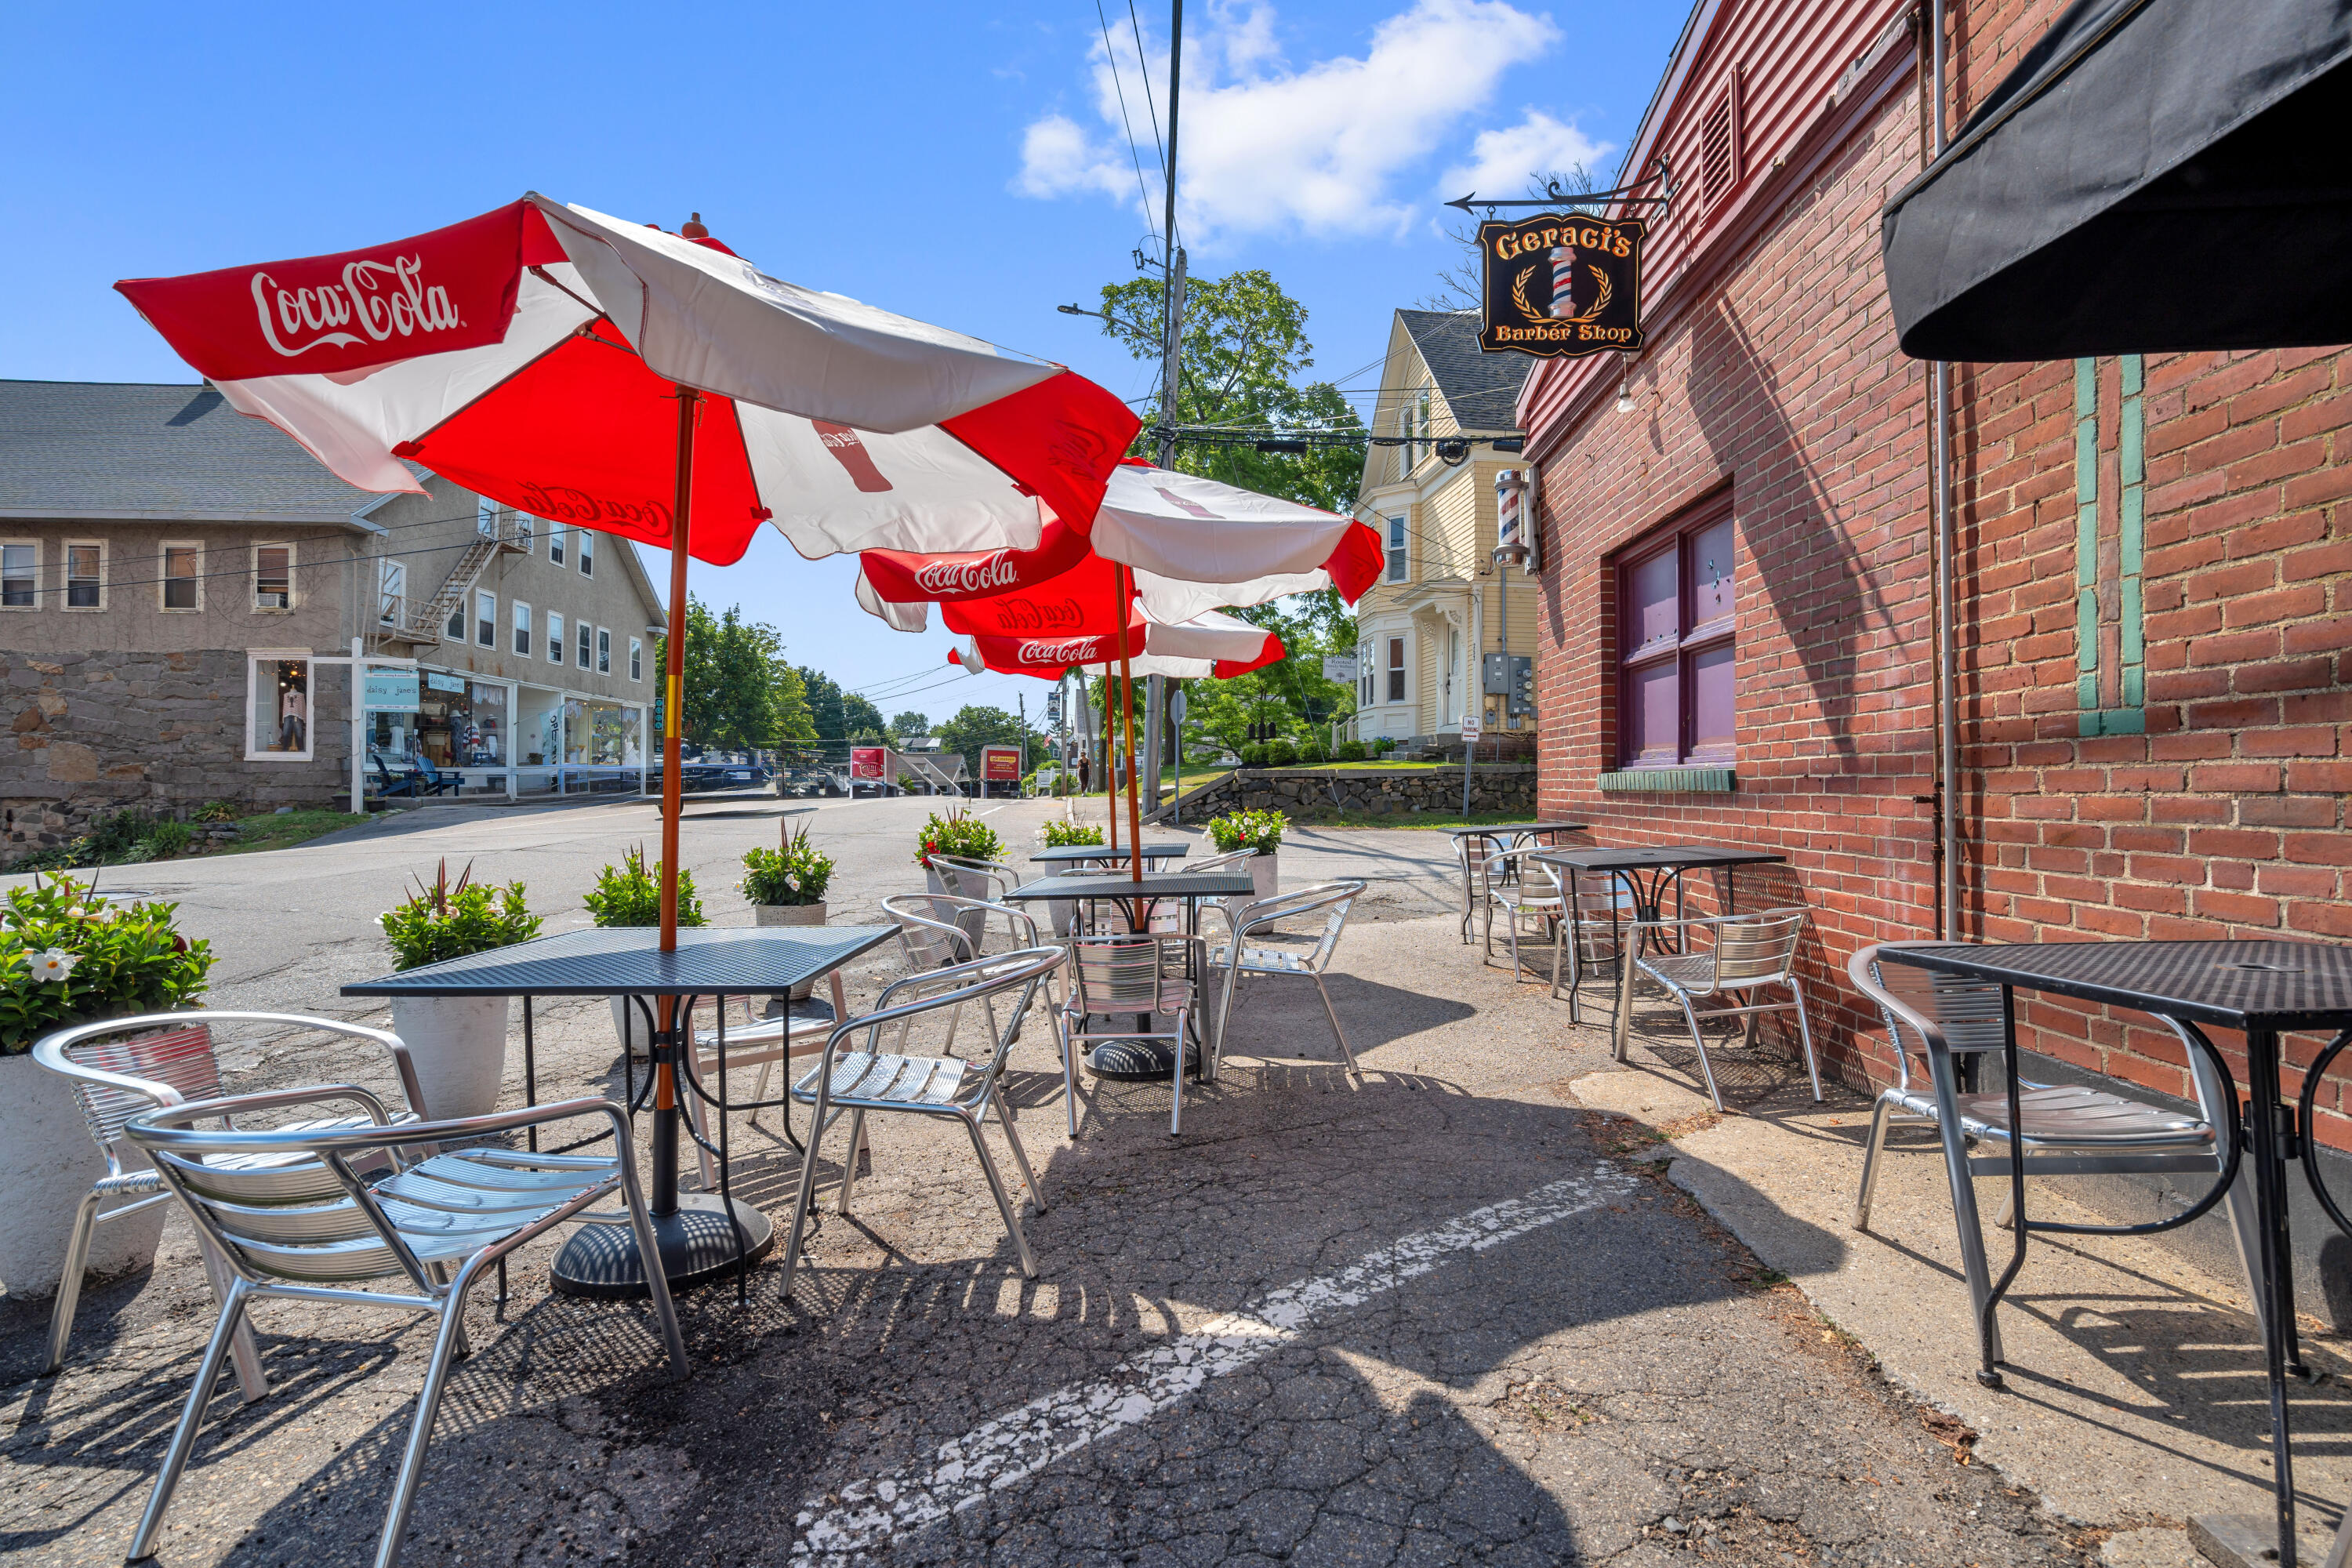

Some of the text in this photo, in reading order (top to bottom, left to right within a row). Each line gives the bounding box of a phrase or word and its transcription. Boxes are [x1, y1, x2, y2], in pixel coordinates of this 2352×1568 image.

[1497, 227, 1632, 260] Geraci's
[251, 253, 459, 357] Coca-Cola
[1495, 325, 1632, 343] Barber Shop
[915, 549, 1017, 594] Coca-Cola
[1018, 636, 1098, 664] Coca-Cola
[367, 685, 417, 695] daisy jane's
[430, 677, 444, 687] daisy
